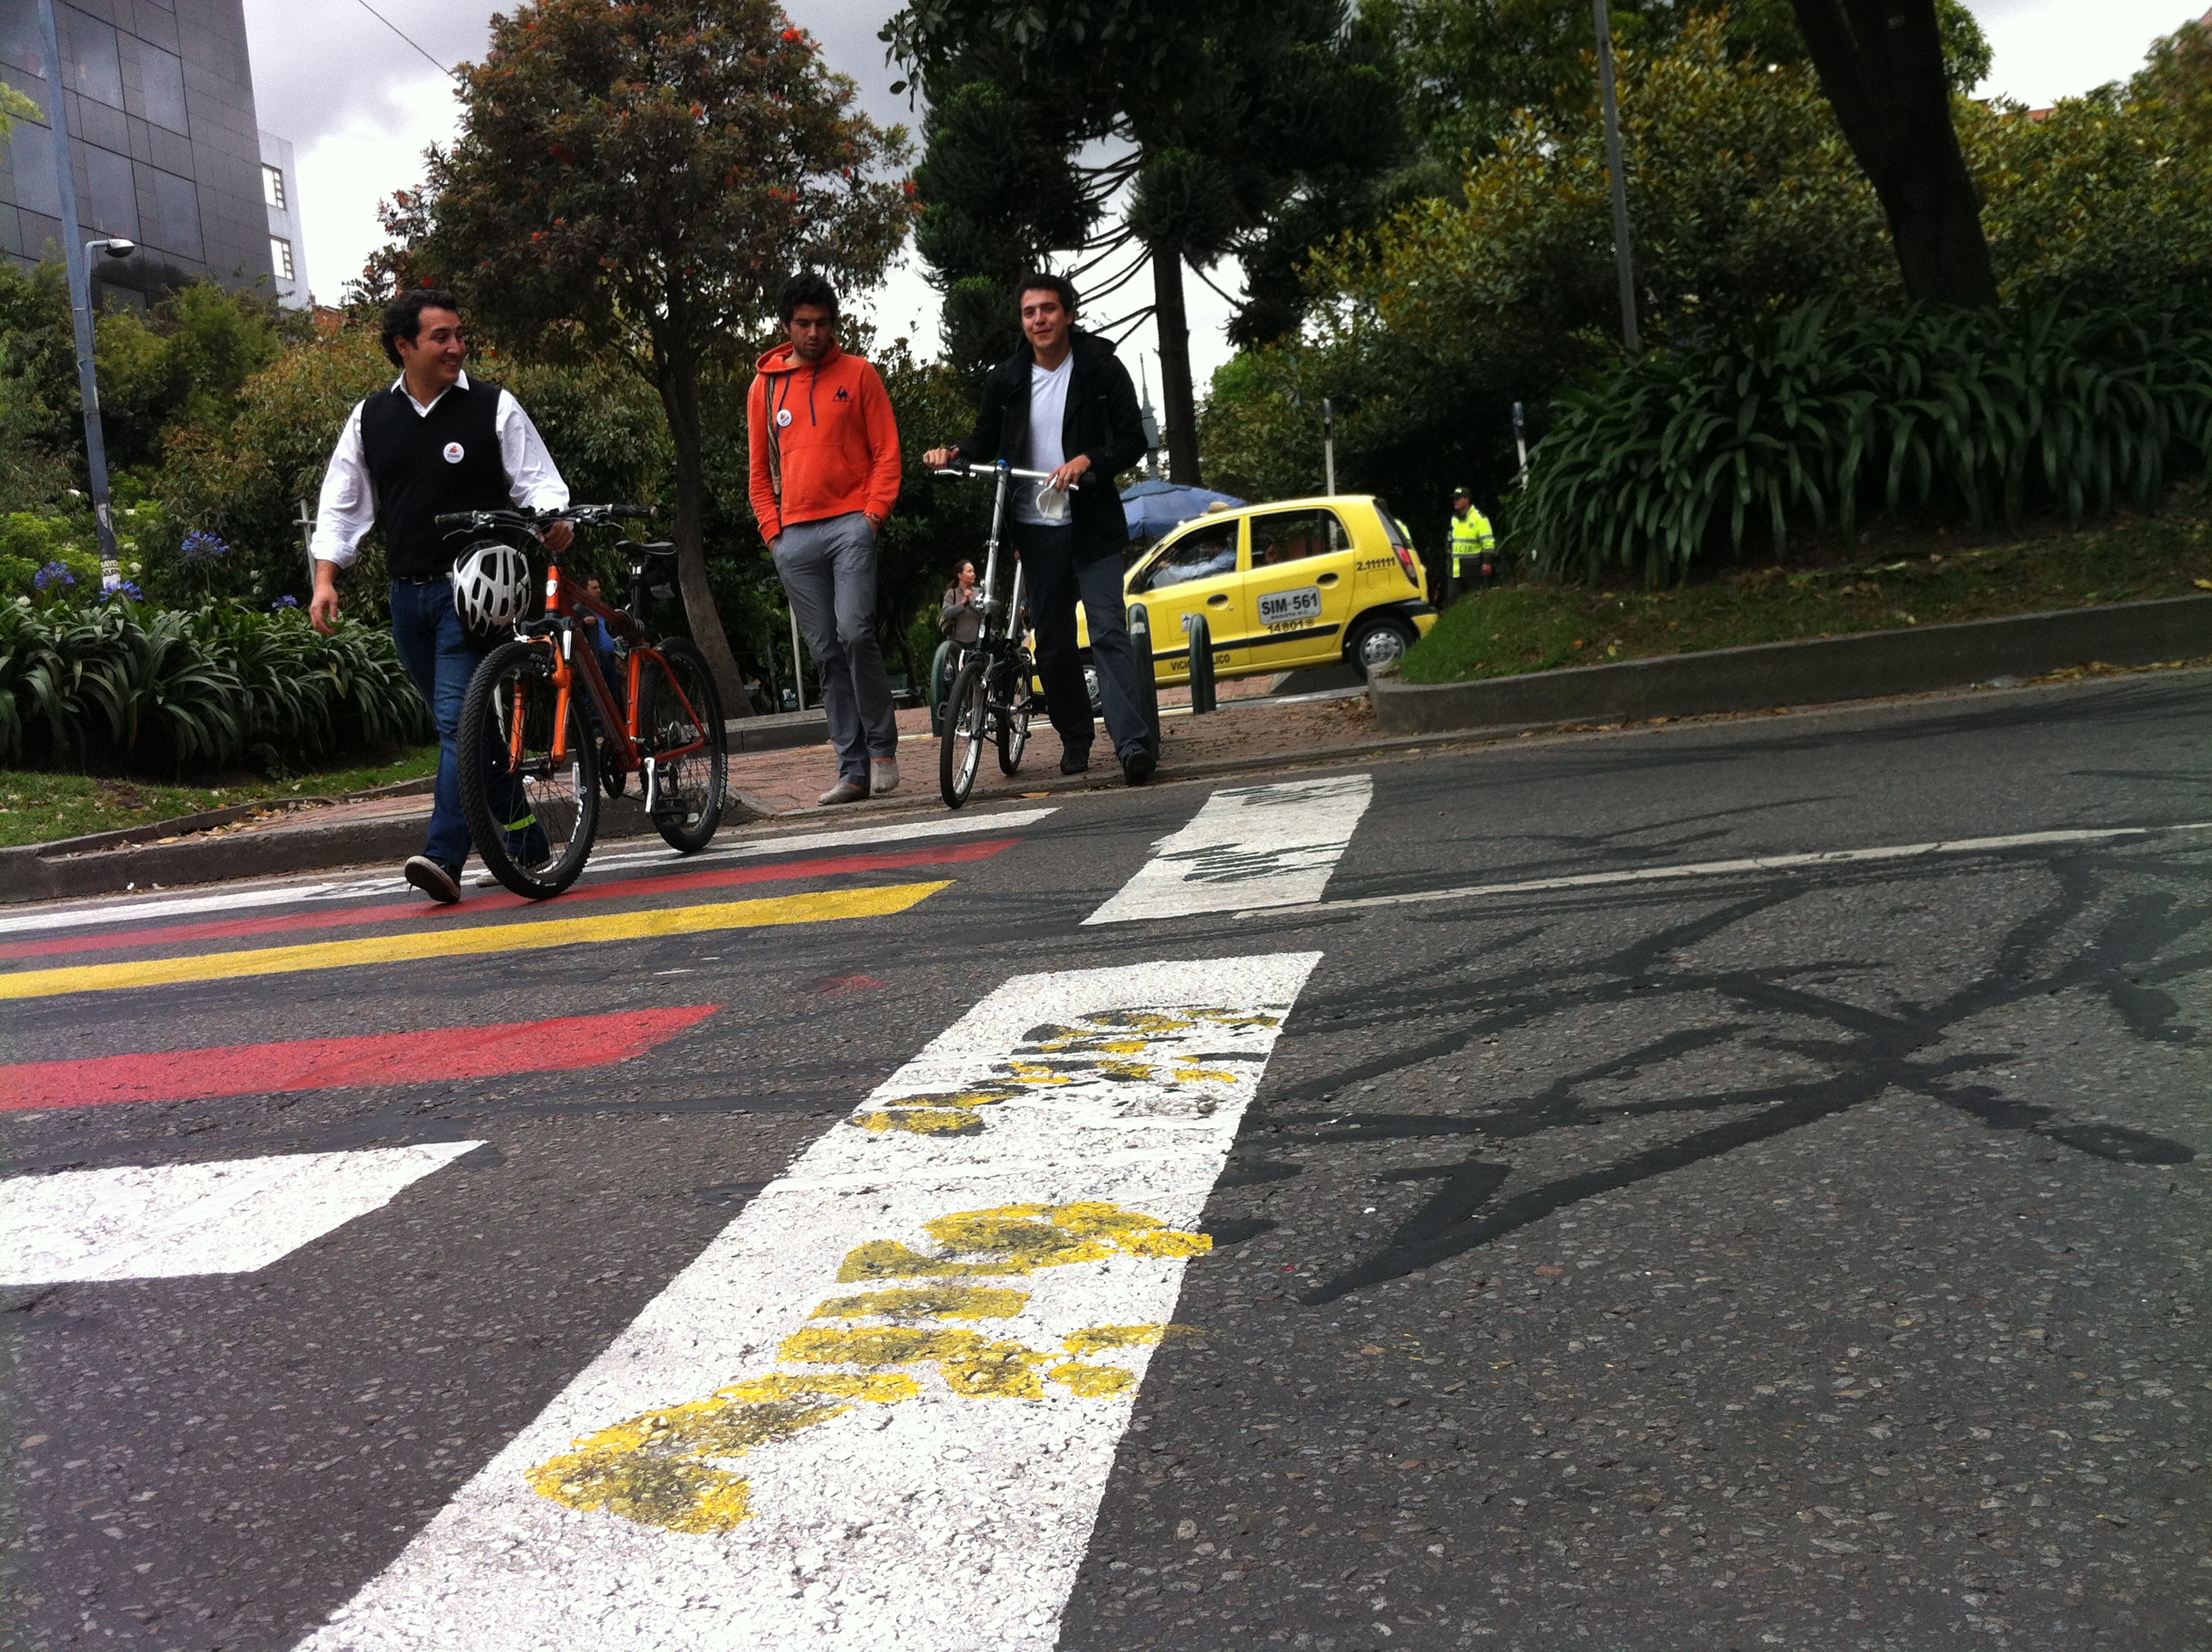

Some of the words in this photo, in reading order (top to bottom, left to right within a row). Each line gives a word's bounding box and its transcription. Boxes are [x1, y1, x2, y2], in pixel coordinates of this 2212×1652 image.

[1357, 557, 1395, 571] 2.111111
[1261, 598, 1287, 615] SIM
[1293, 593, 1317, 610] 561
